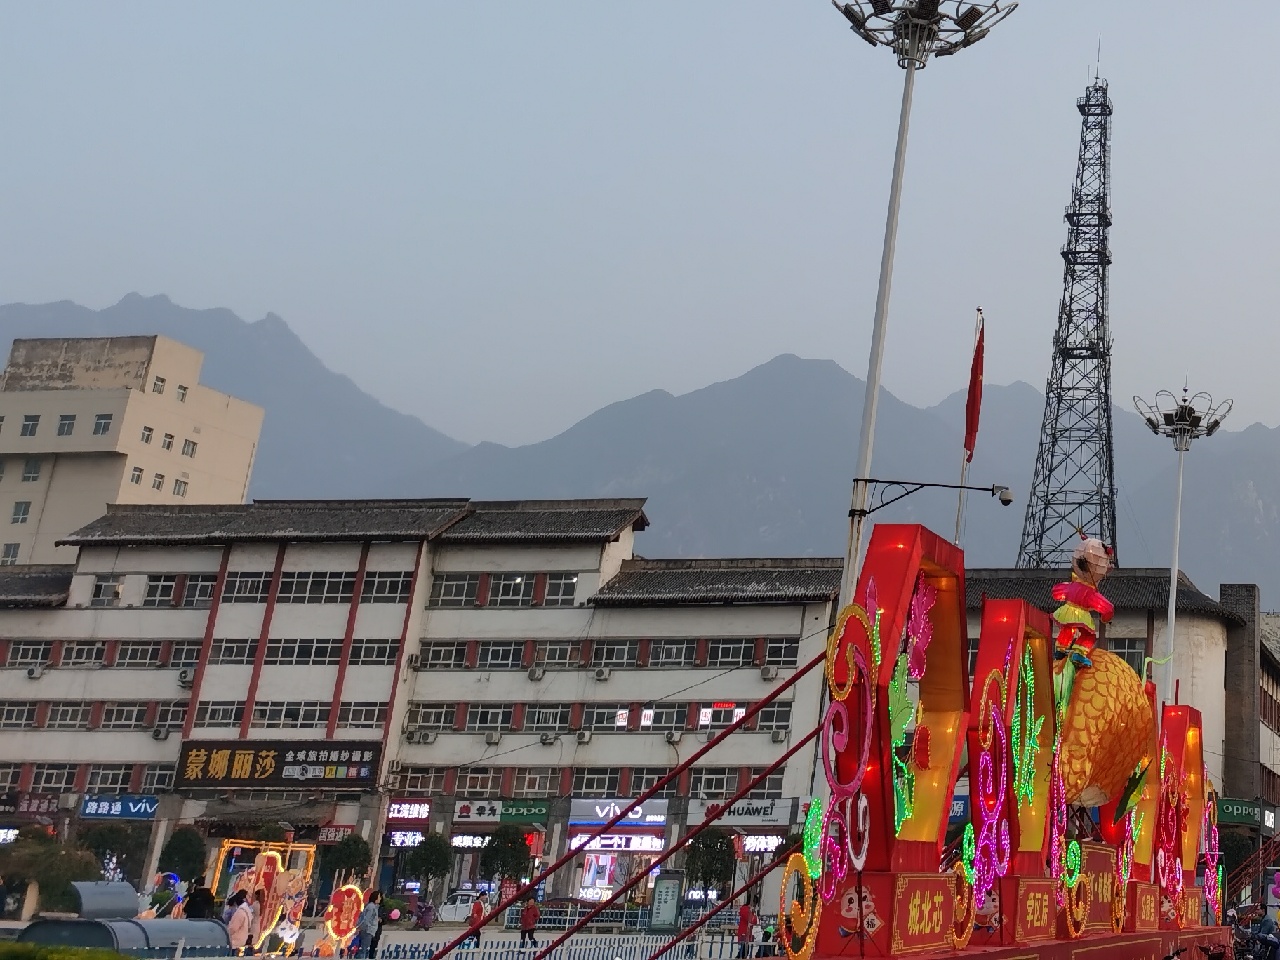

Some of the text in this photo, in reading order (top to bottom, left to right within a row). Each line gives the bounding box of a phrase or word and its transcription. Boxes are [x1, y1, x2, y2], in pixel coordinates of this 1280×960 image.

[285, 750, 373, 762] 全球旅拍婚纱摄影
[184, 749, 278, 780] 蒙娜丽莎
[86, 801, 122, 814] 路路通
[129, 799, 160, 813] viv
[476, 805, 497, 817] 华为
[501, 807, 547, 815] oppo
[728, 805, 774, 816] HUAWEI
[1027, 892, 1048, 928] 学区房
[866, 918, 876, 929] 福
